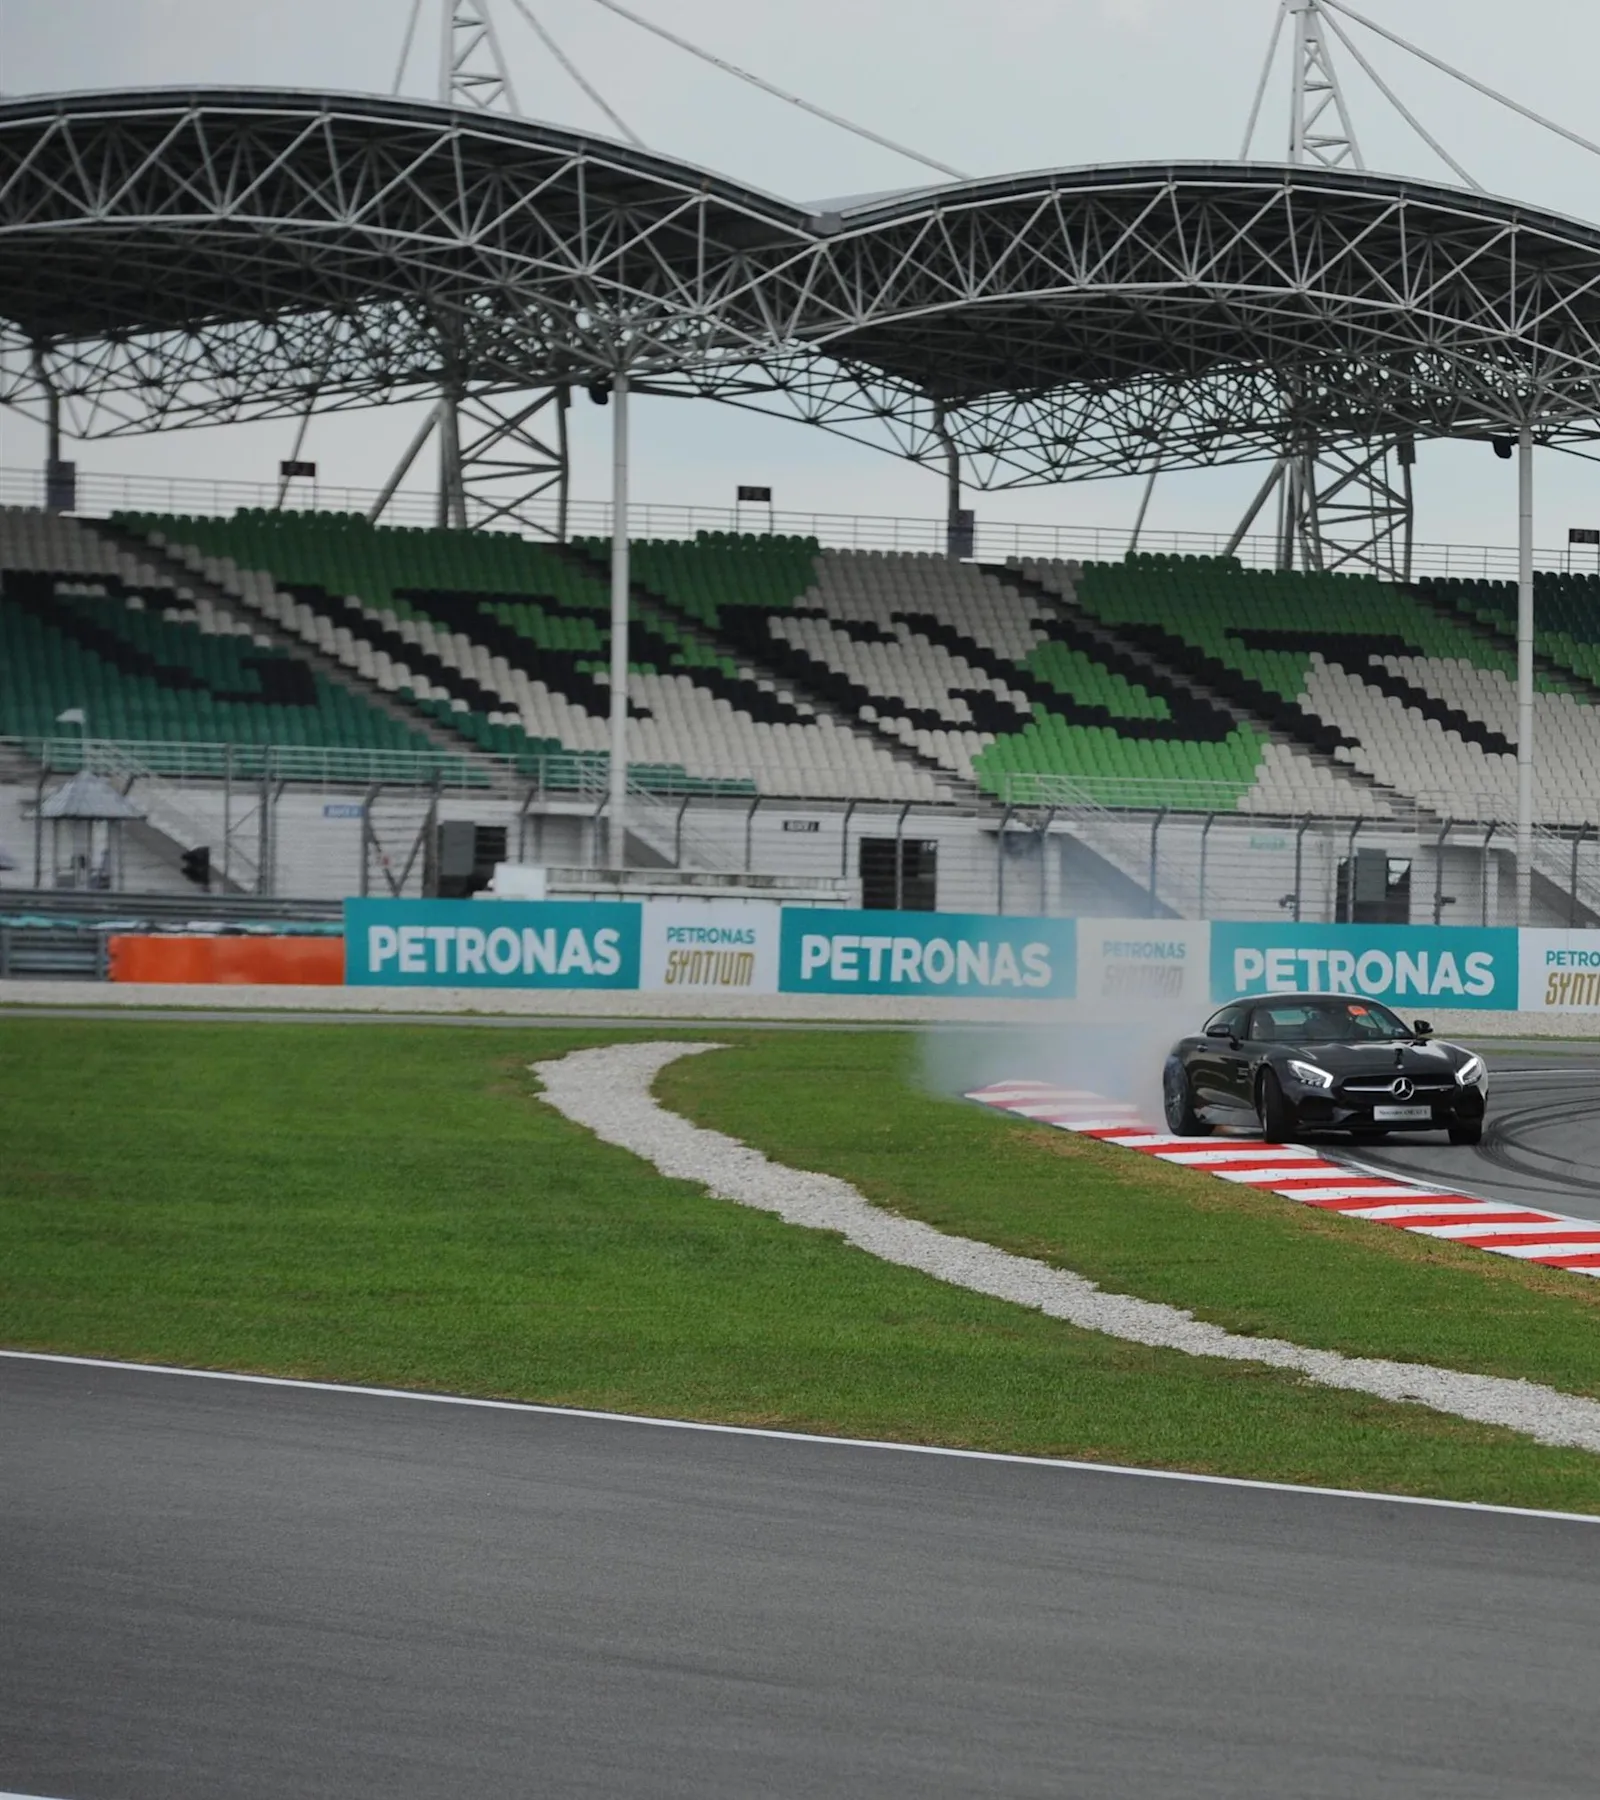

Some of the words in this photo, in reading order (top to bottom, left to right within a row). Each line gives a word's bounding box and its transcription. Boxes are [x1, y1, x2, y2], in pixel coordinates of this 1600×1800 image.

[368, 925, 621, 976] PETRONAS
[666, 926, 756, 945] PETRONAS
[1102, 940, 1186, 959] PETRONAS
[664, 949, 755, 987] SYNTIUM
[801, 934, 1052, 988] PETRONAS
[1234, 948, 1495, 996] PETRONAS
